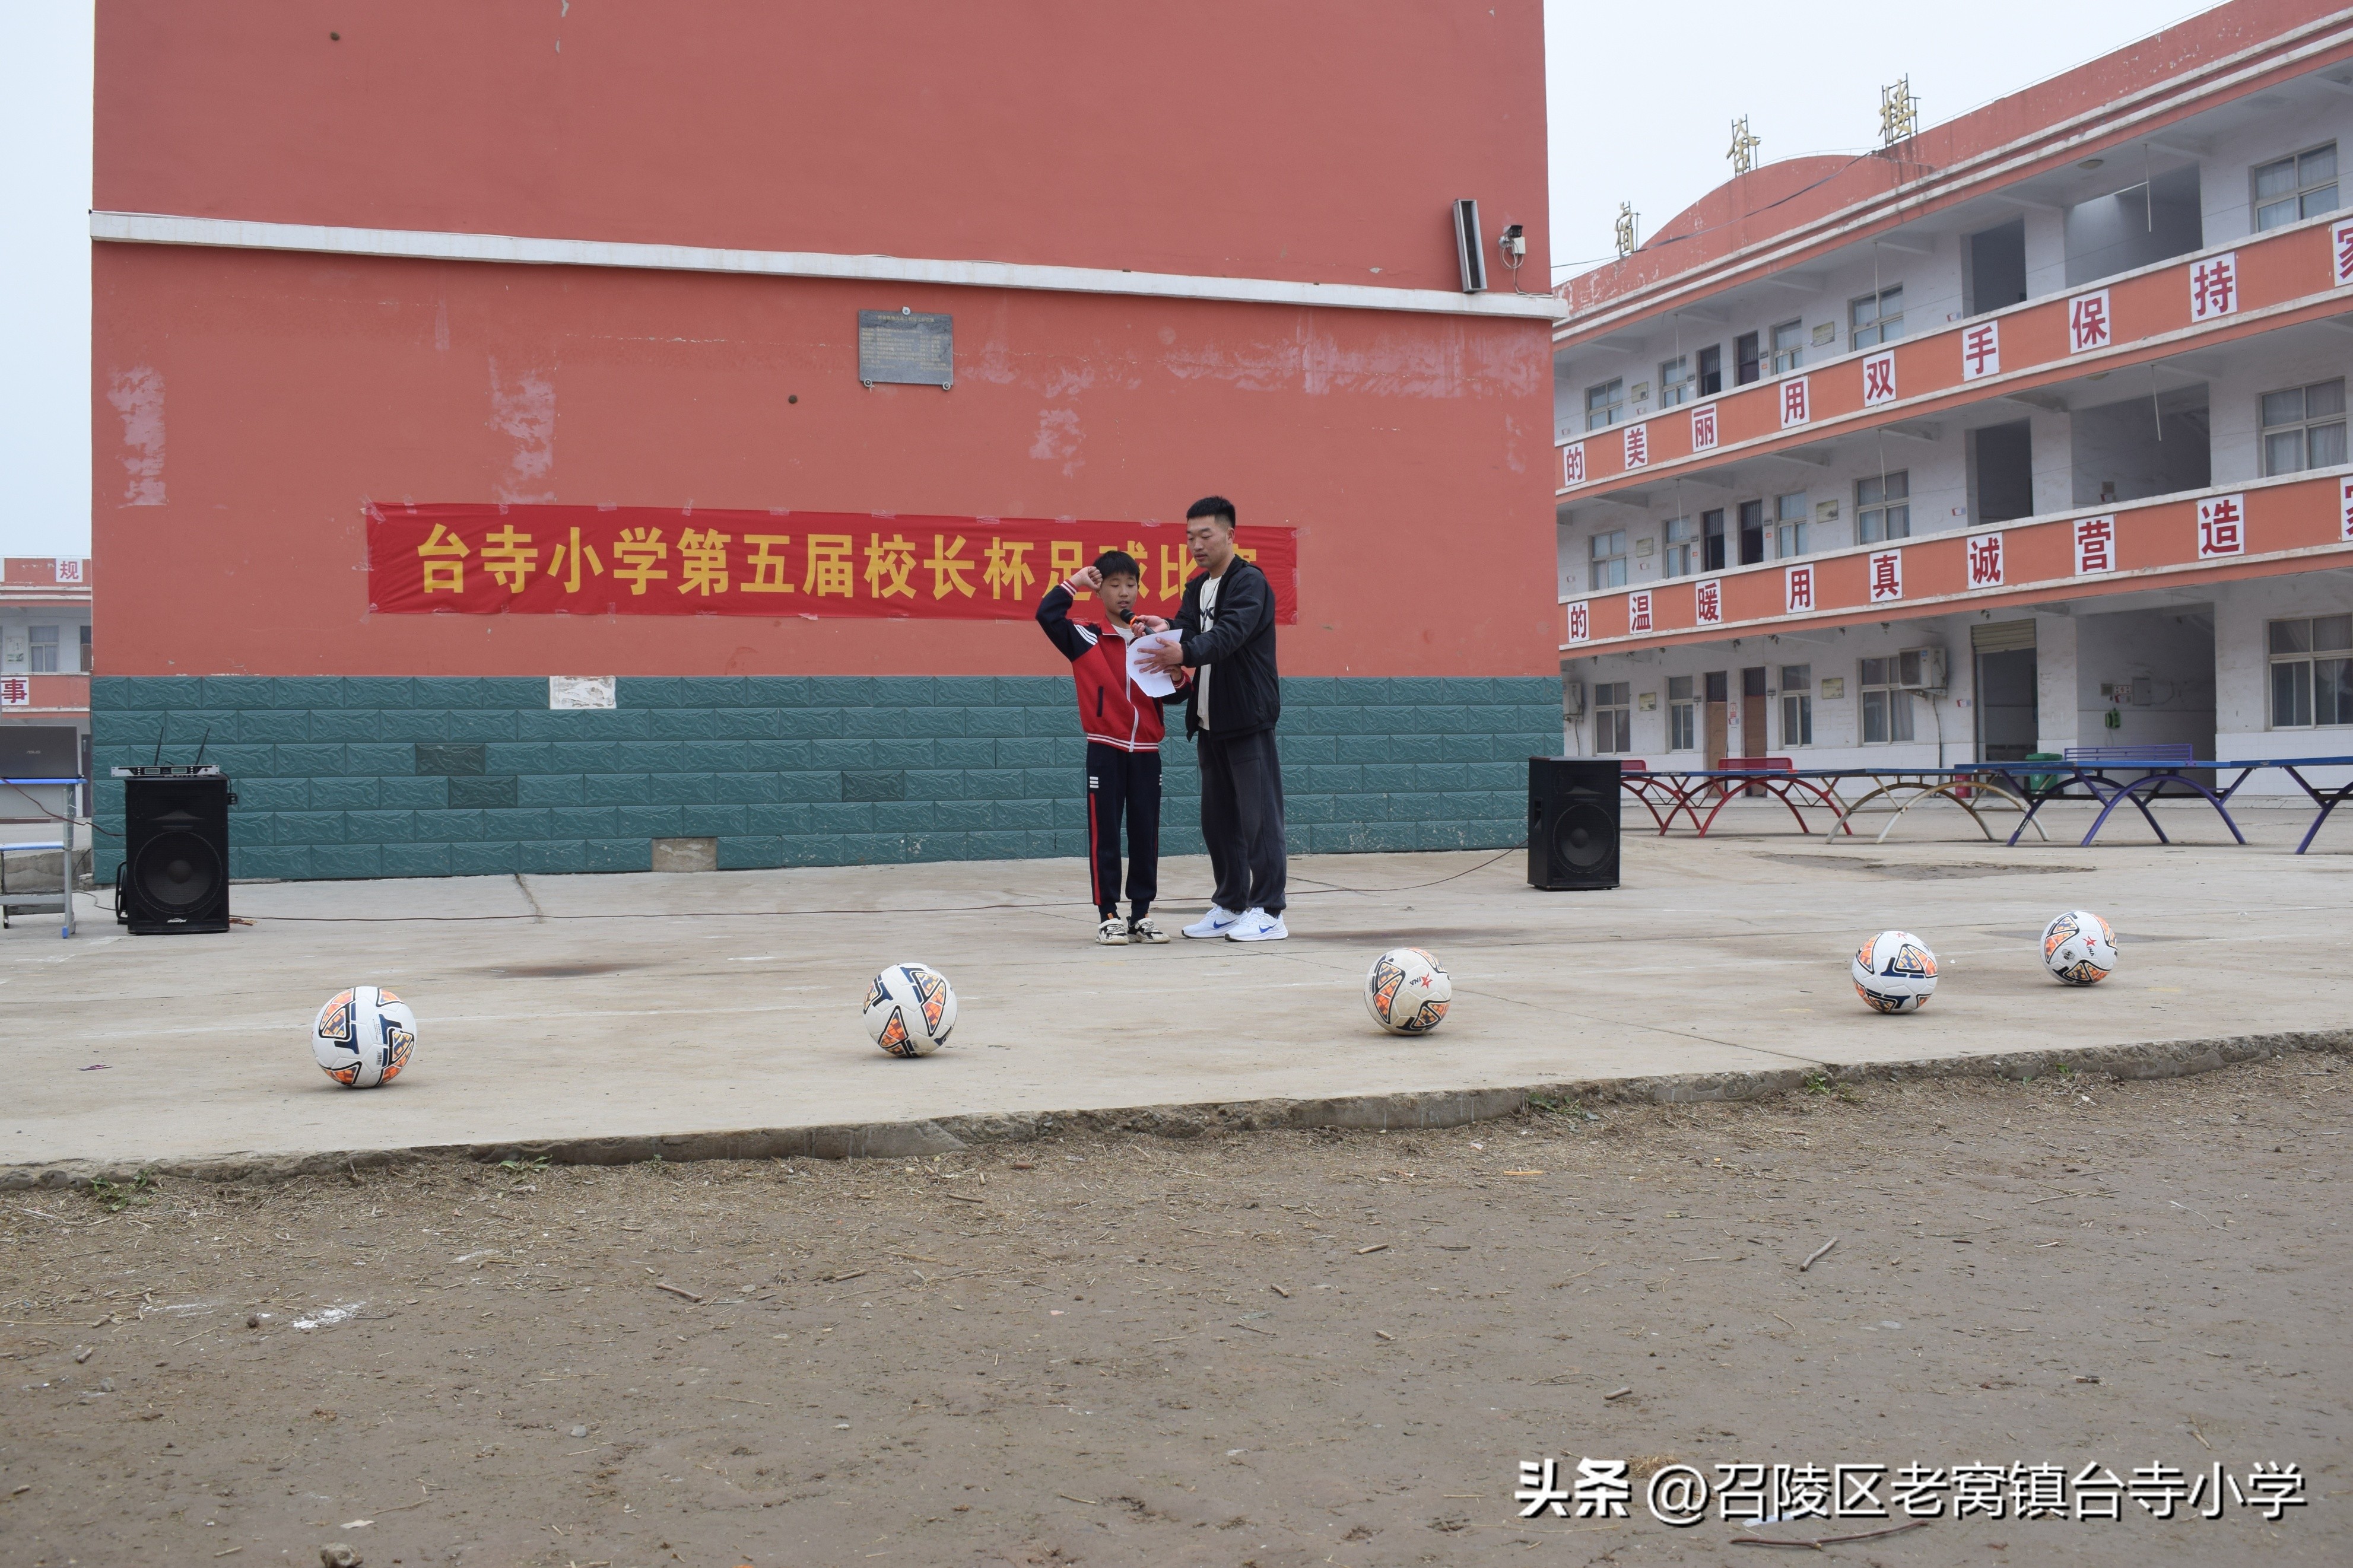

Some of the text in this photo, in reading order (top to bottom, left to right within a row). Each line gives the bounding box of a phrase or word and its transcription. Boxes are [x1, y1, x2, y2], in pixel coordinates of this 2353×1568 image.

[60, 561, 79, 580] 规
[417, 523, 1257, 602] 台寺小学第五届校长杯足比
[2, 679, 27, 703] 事
